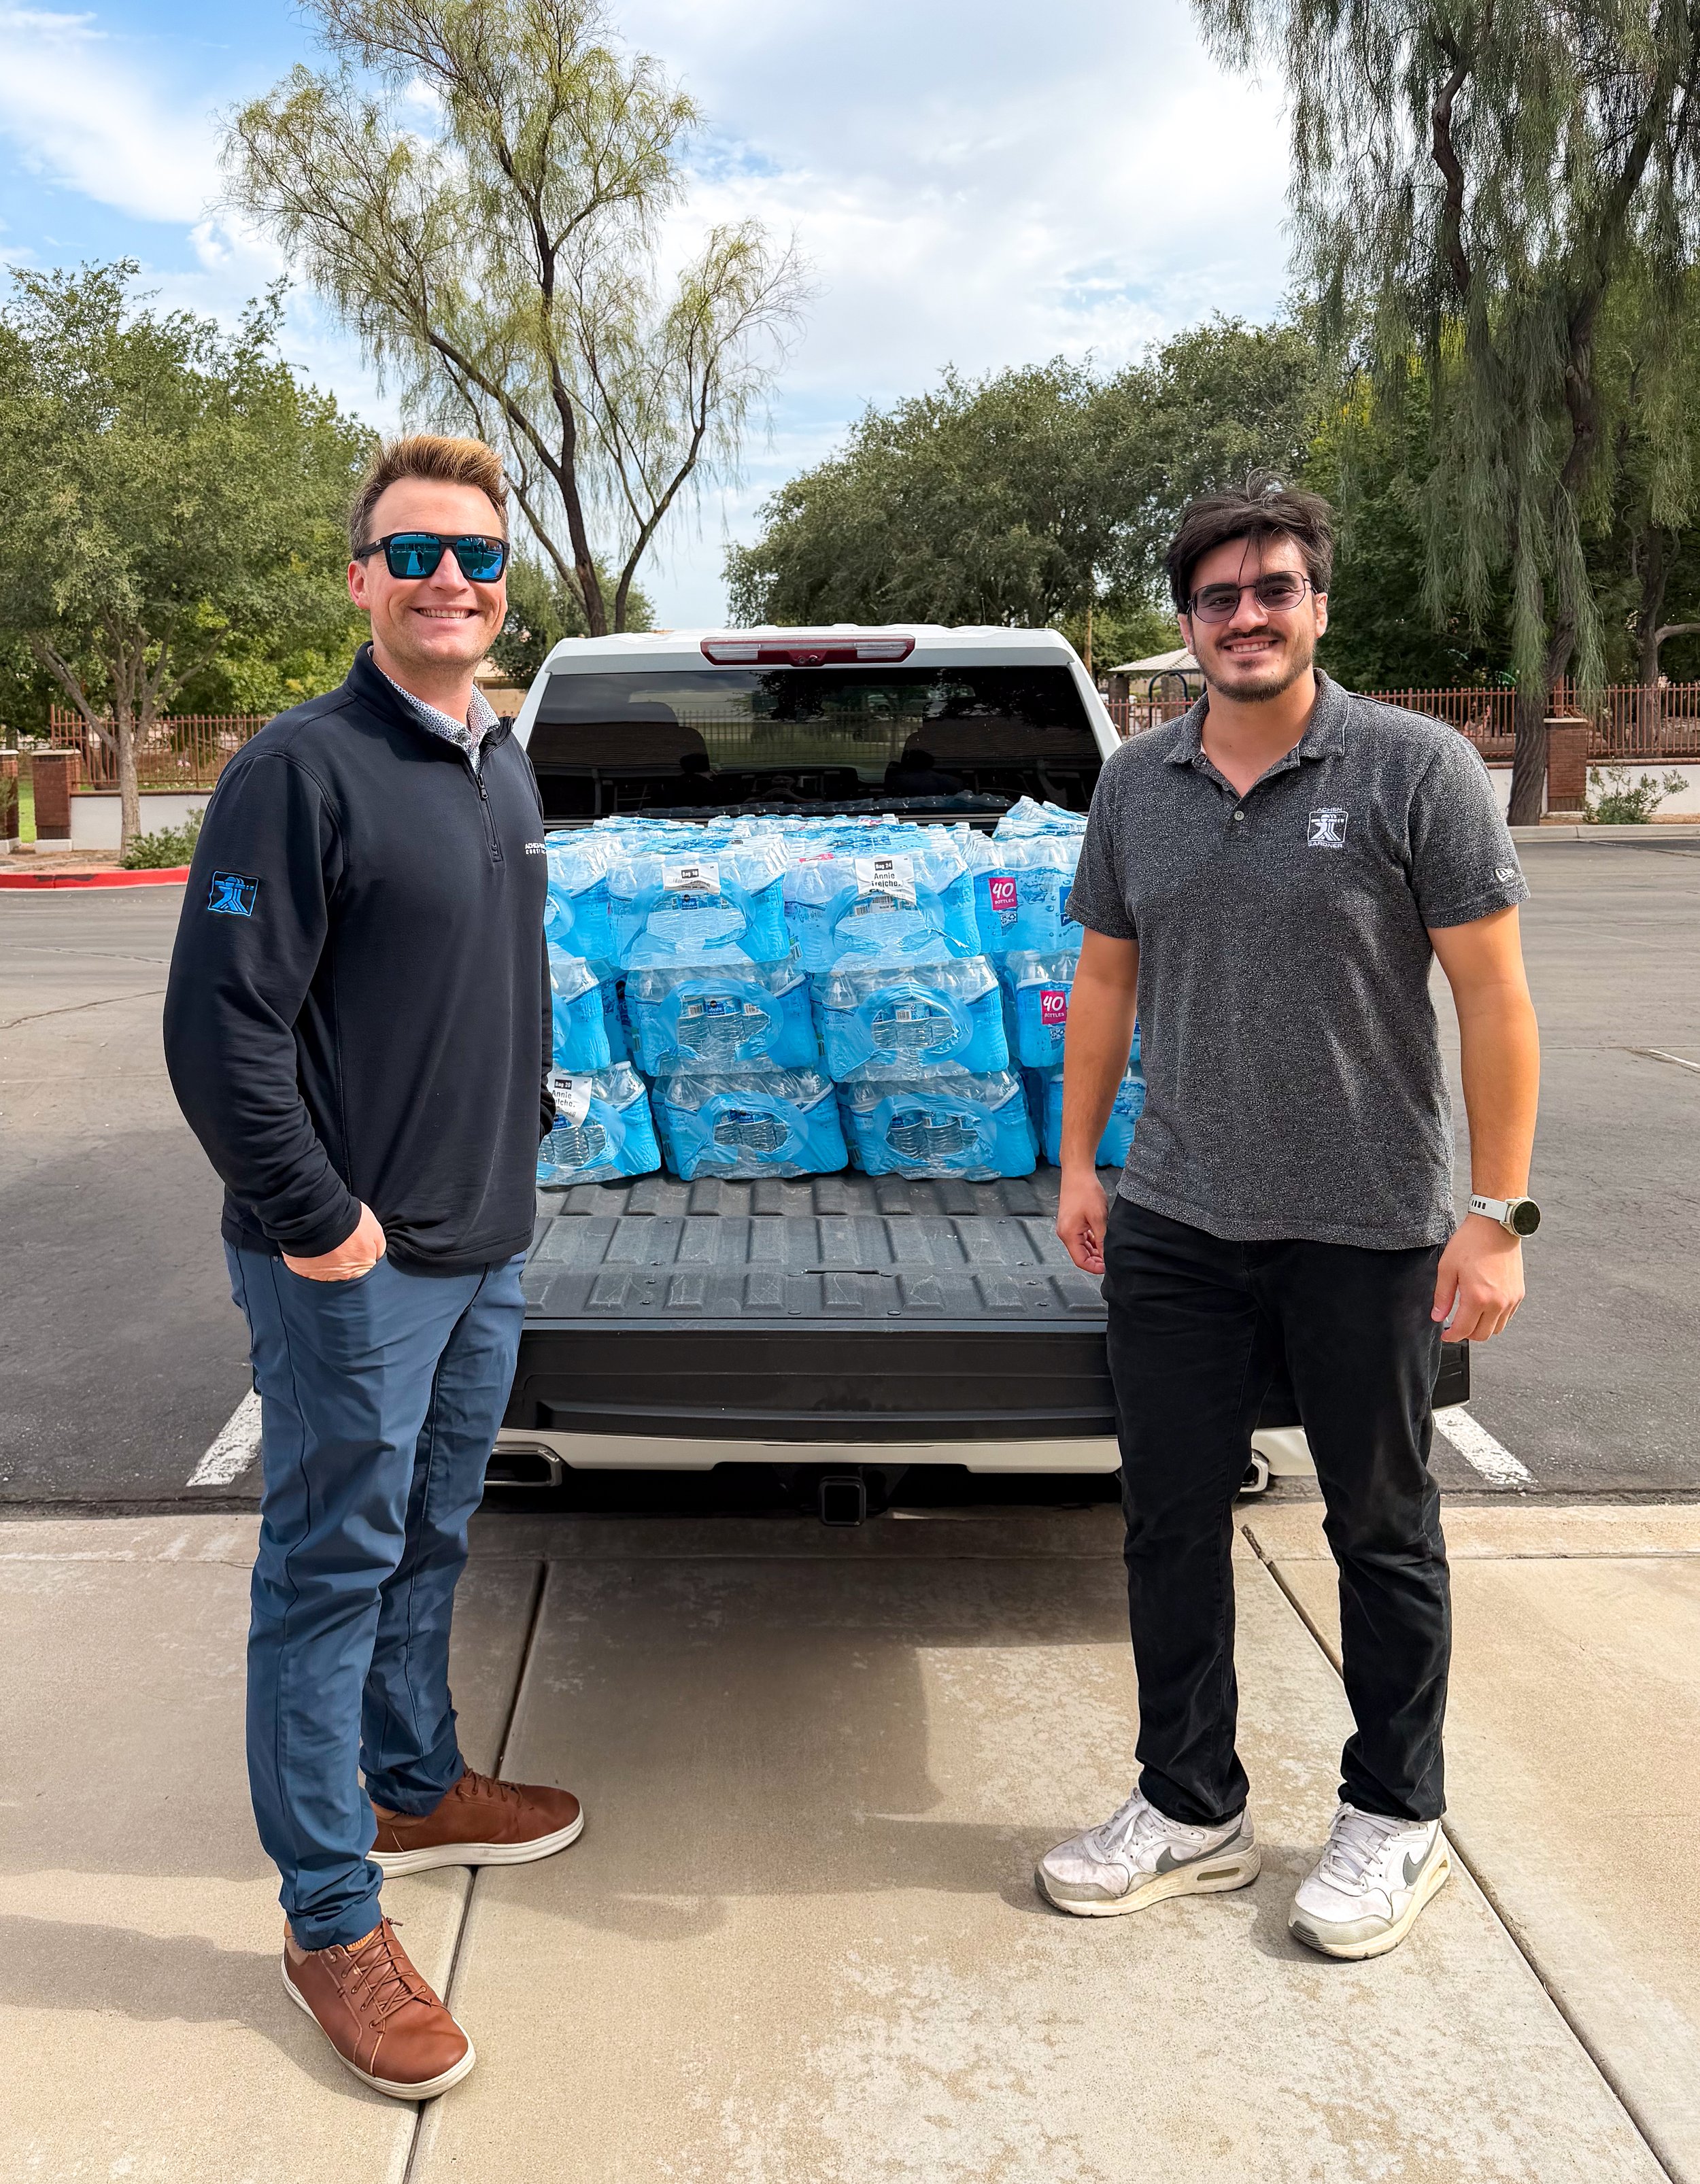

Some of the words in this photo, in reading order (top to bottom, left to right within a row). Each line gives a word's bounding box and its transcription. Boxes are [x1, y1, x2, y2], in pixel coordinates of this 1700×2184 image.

[874, 872, 895, 881] Annie
[992, 883, 1014, 899] 40
[1042, 995, 1064, 1012] 40
[551, 1089, 572, 1099] Annie
